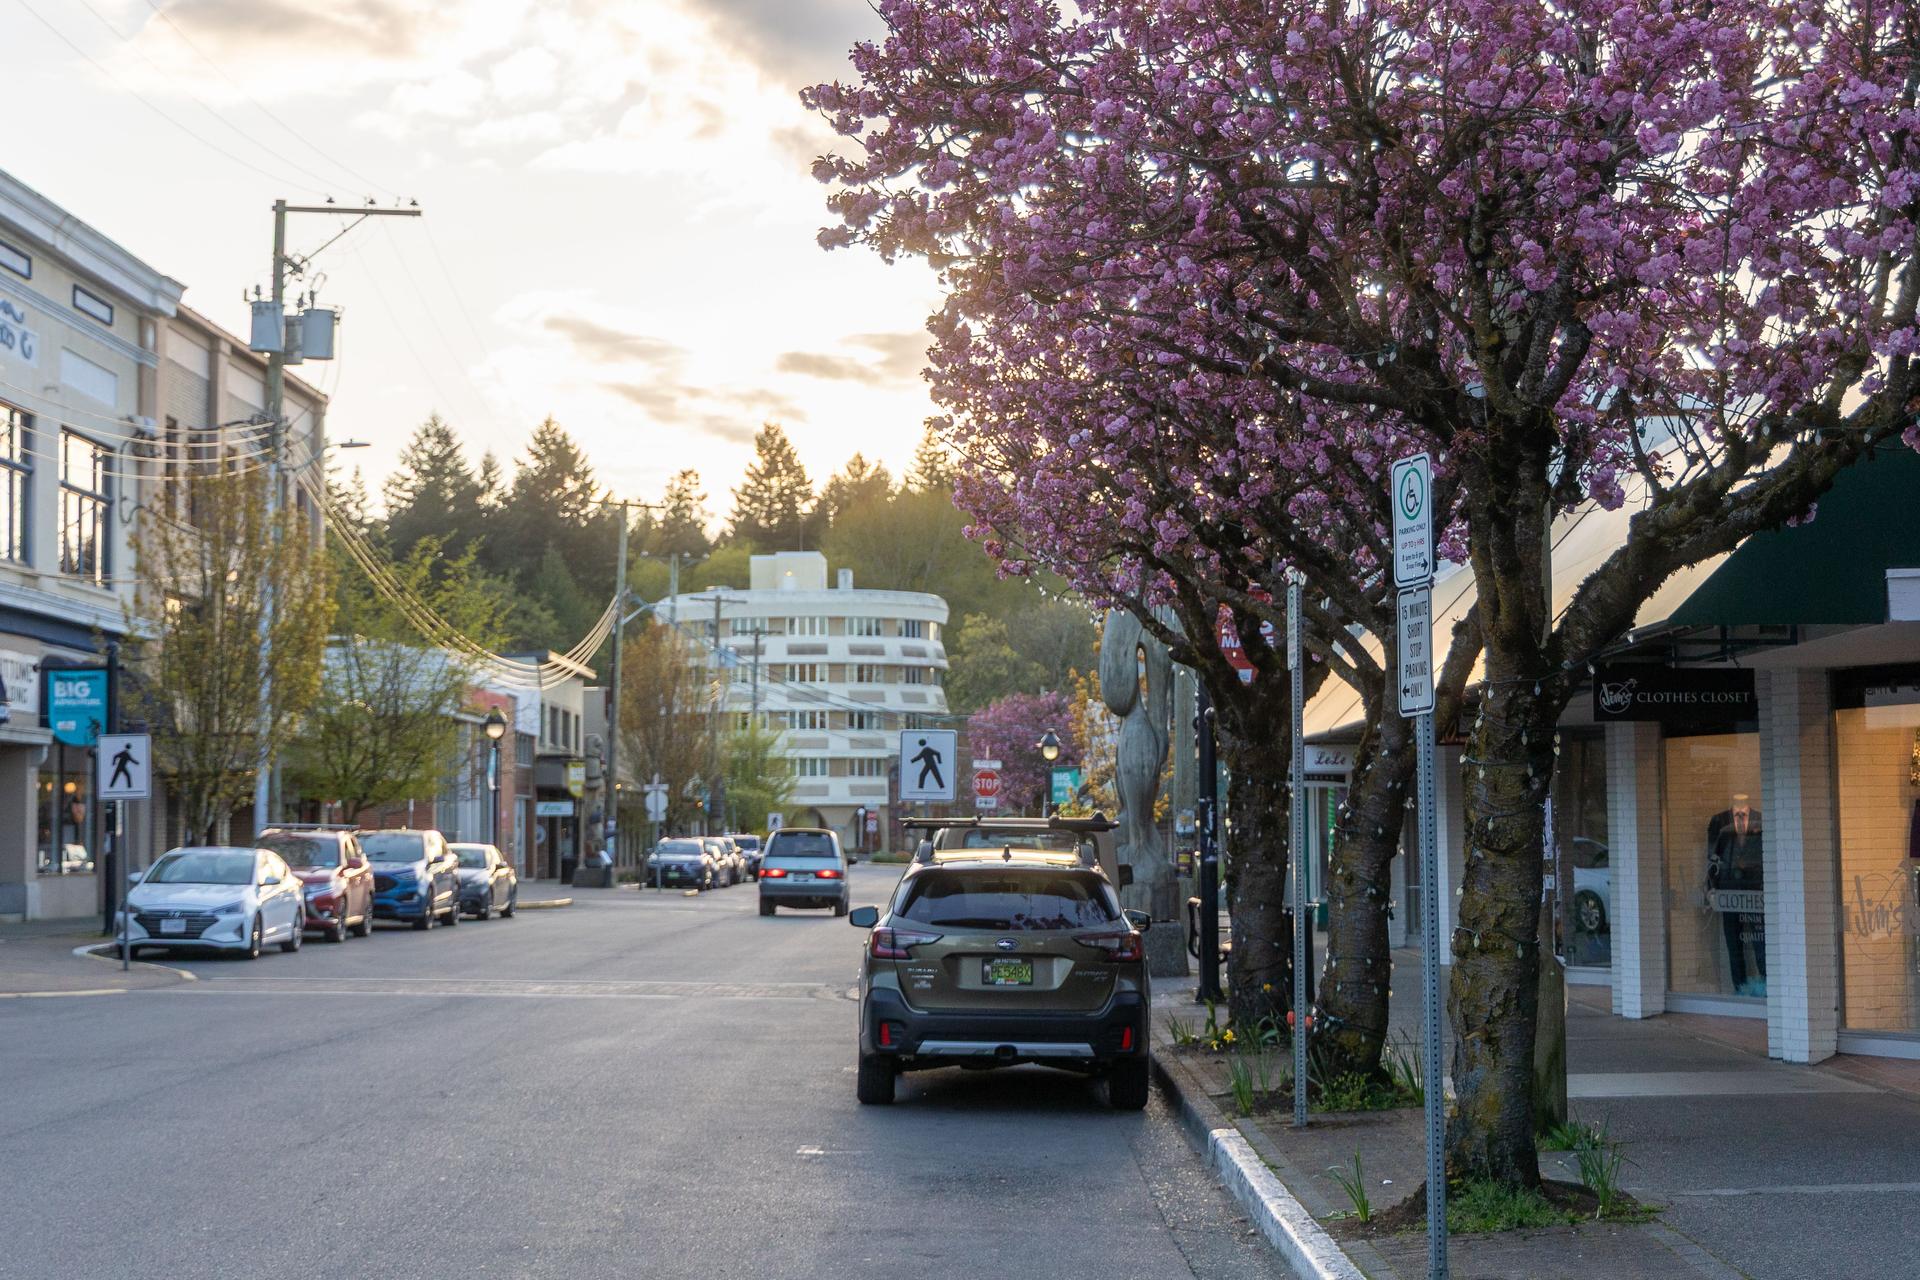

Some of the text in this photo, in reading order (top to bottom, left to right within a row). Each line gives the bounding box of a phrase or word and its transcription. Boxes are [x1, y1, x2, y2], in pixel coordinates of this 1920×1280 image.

[1398, 522, 1426, 536] PARKING ONLY
[1401, 601, 1428, 620] 15 MINUTE
[1407, 622, 1423, 639] SHORT
[1409, 642, 1422, 658] STOP
[1405, 661, 1427, 679] PARKING
[54, 681, 91, 698] BIG
[1410, 682, 1423, 698] ONLY
[1601, 683, 1750, 706] Jim's CLOTHES CLOSET
[974, 778, 1001, 789] STOP
